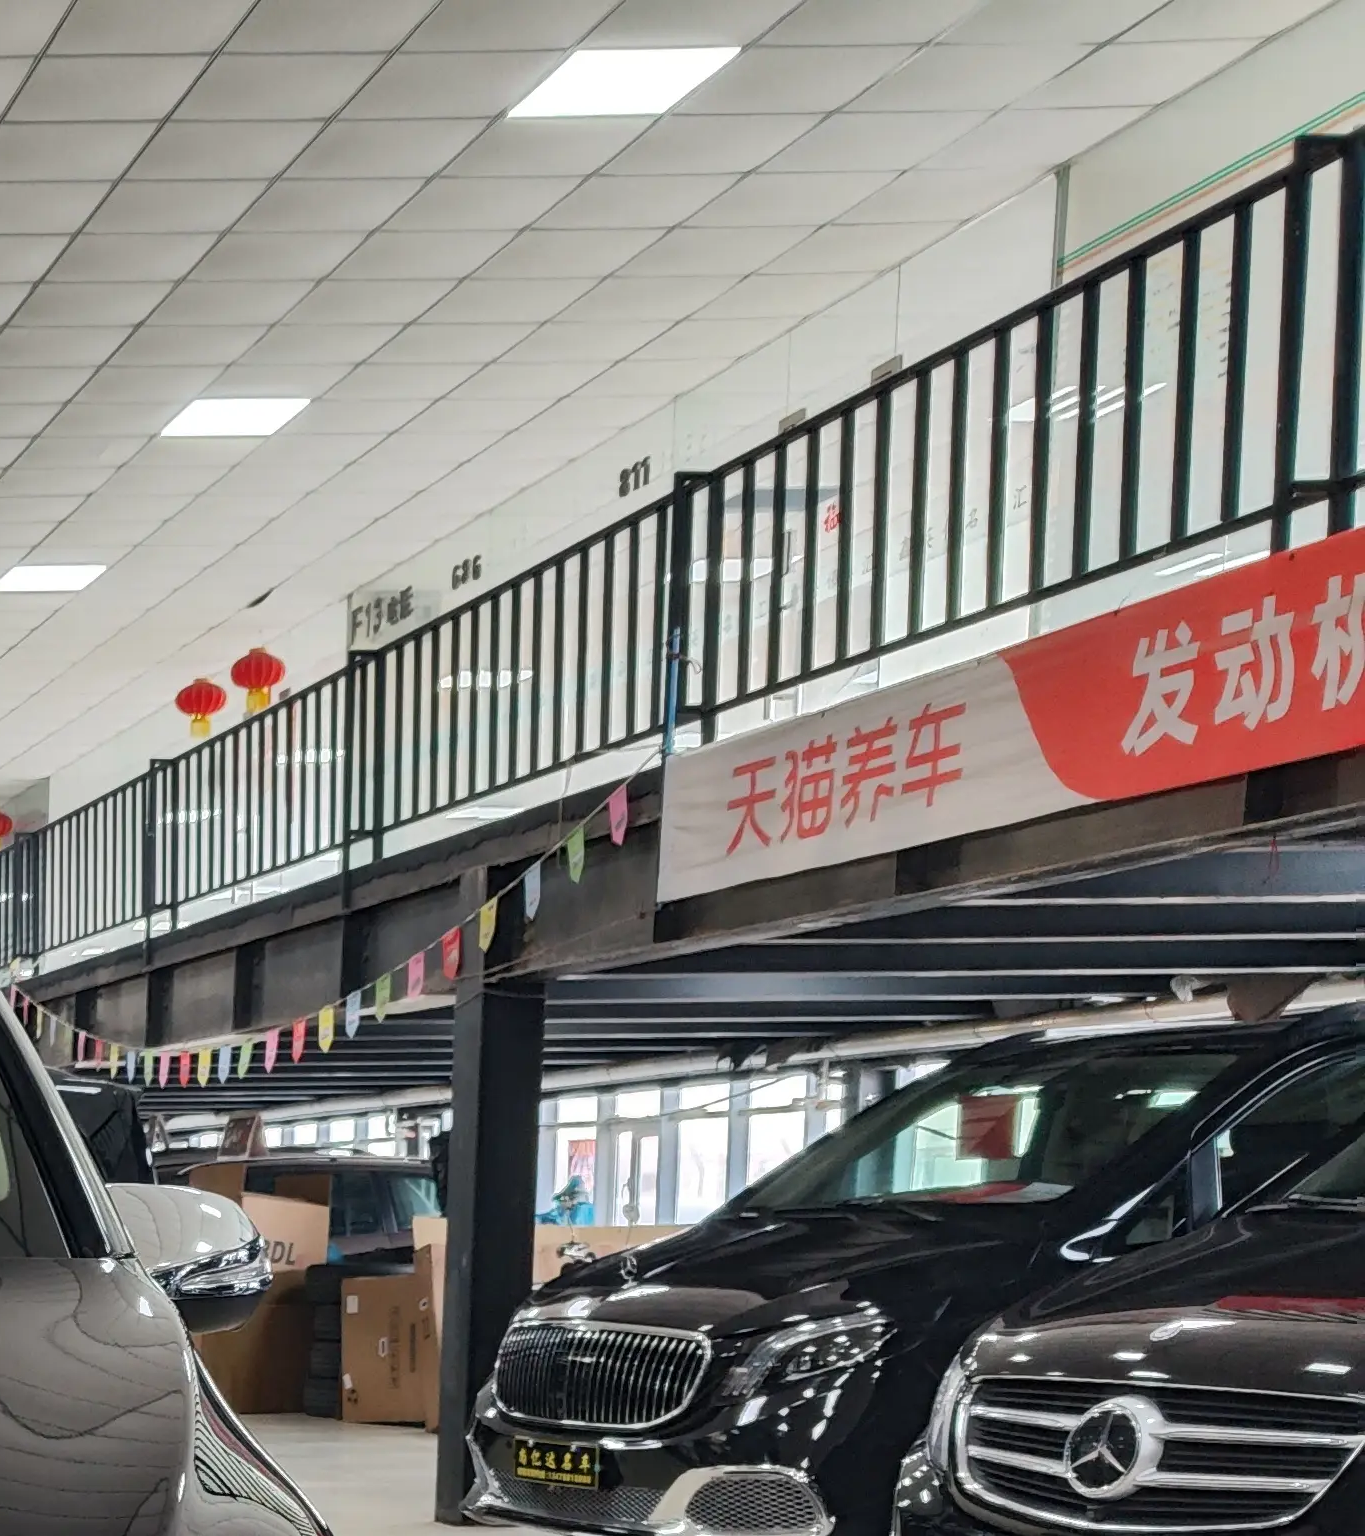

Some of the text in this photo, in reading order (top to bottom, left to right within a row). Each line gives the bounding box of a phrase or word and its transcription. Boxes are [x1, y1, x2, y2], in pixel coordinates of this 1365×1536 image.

[725, 573, 1365, 857] 天猫养车 发动机
